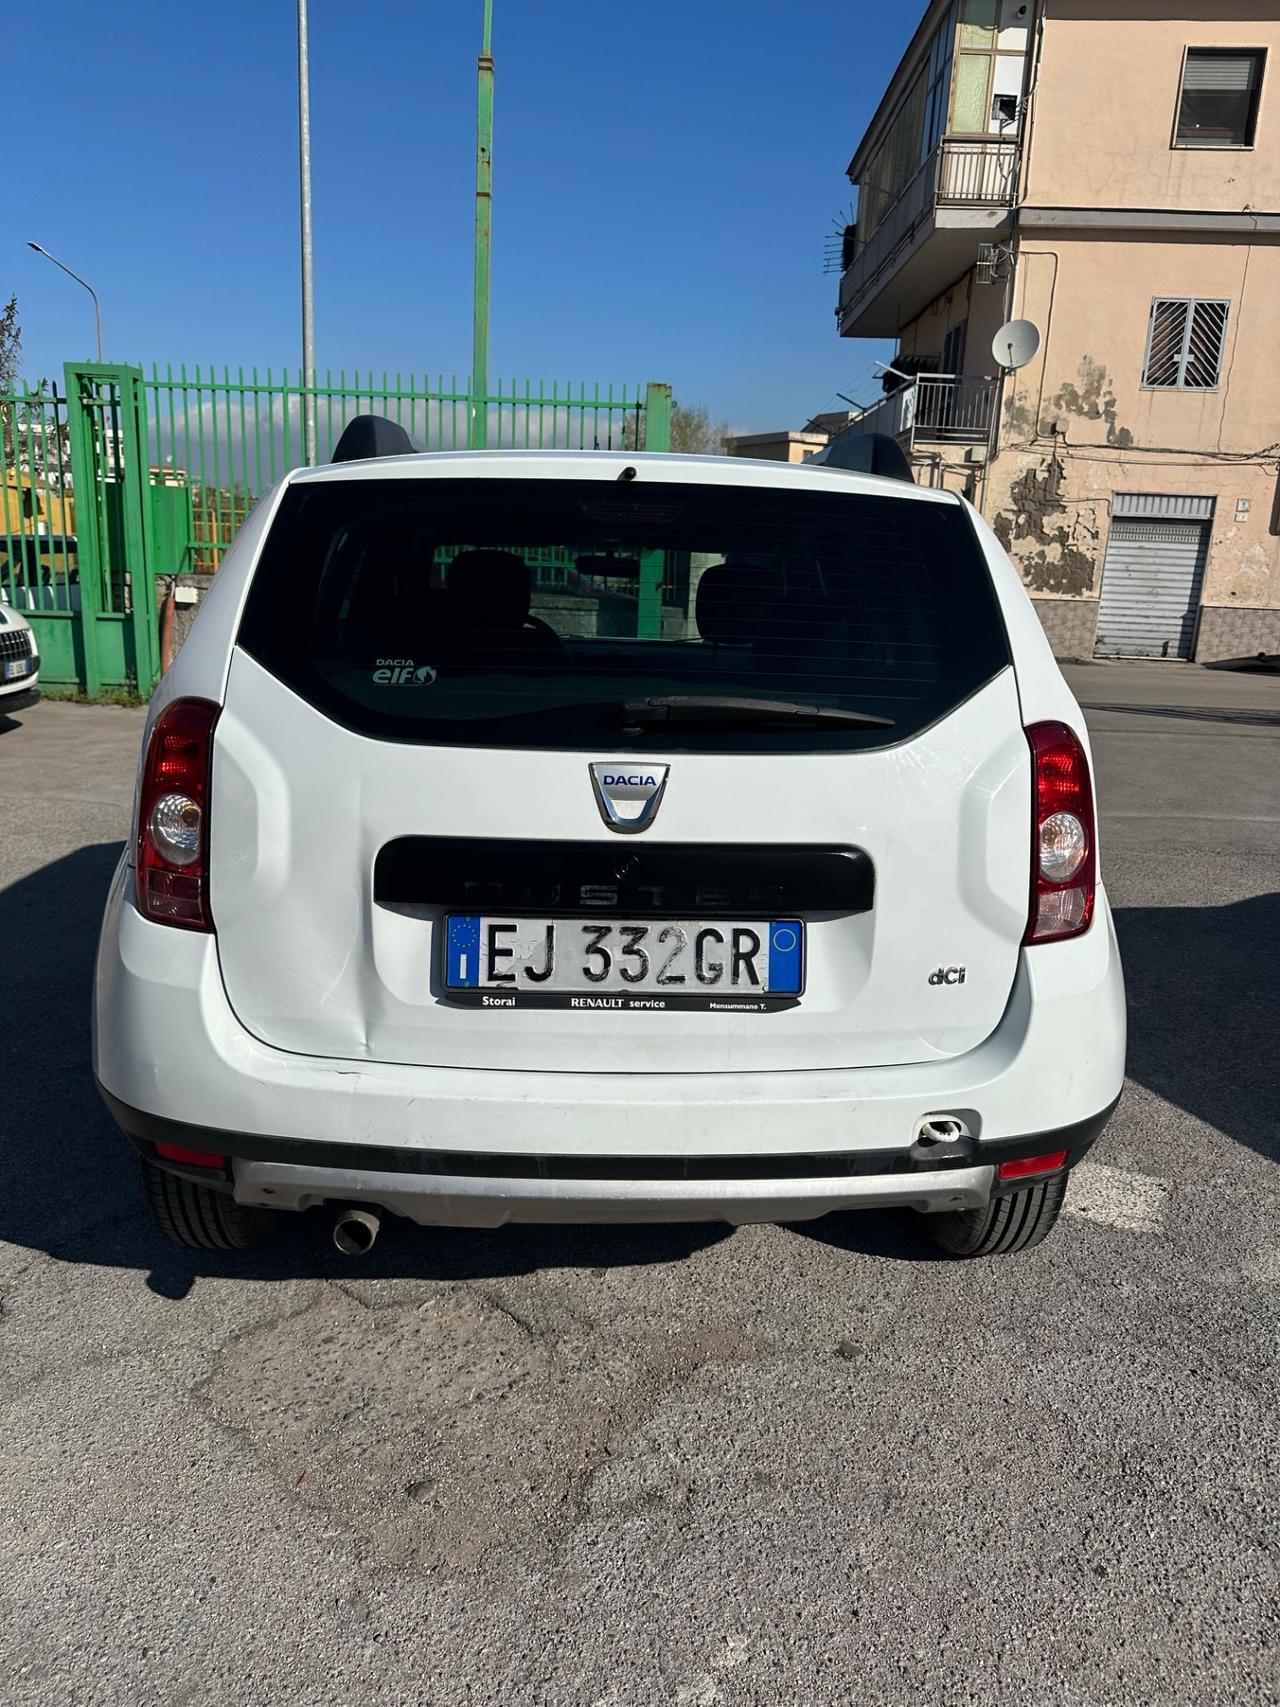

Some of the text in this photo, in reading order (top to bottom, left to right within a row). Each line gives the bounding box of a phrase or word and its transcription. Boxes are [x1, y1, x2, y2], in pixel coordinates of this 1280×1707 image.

[376, 659, 415, 667] DACIA
[373, 668, 414, 684] elf
[603, 775, 657, 786] DACIA
[465, 881, 783, 906] DUSTE
[487, 924, 761, 985] EJ 332GR
[928, 966, 966, 985] dCi
[482, 996, 516, 1007] Storai
[571, 998, 625, 1008] RENAULT
[629, 999, 666, 1008] service
[709, 1002, 758, 1010] Monsummano
